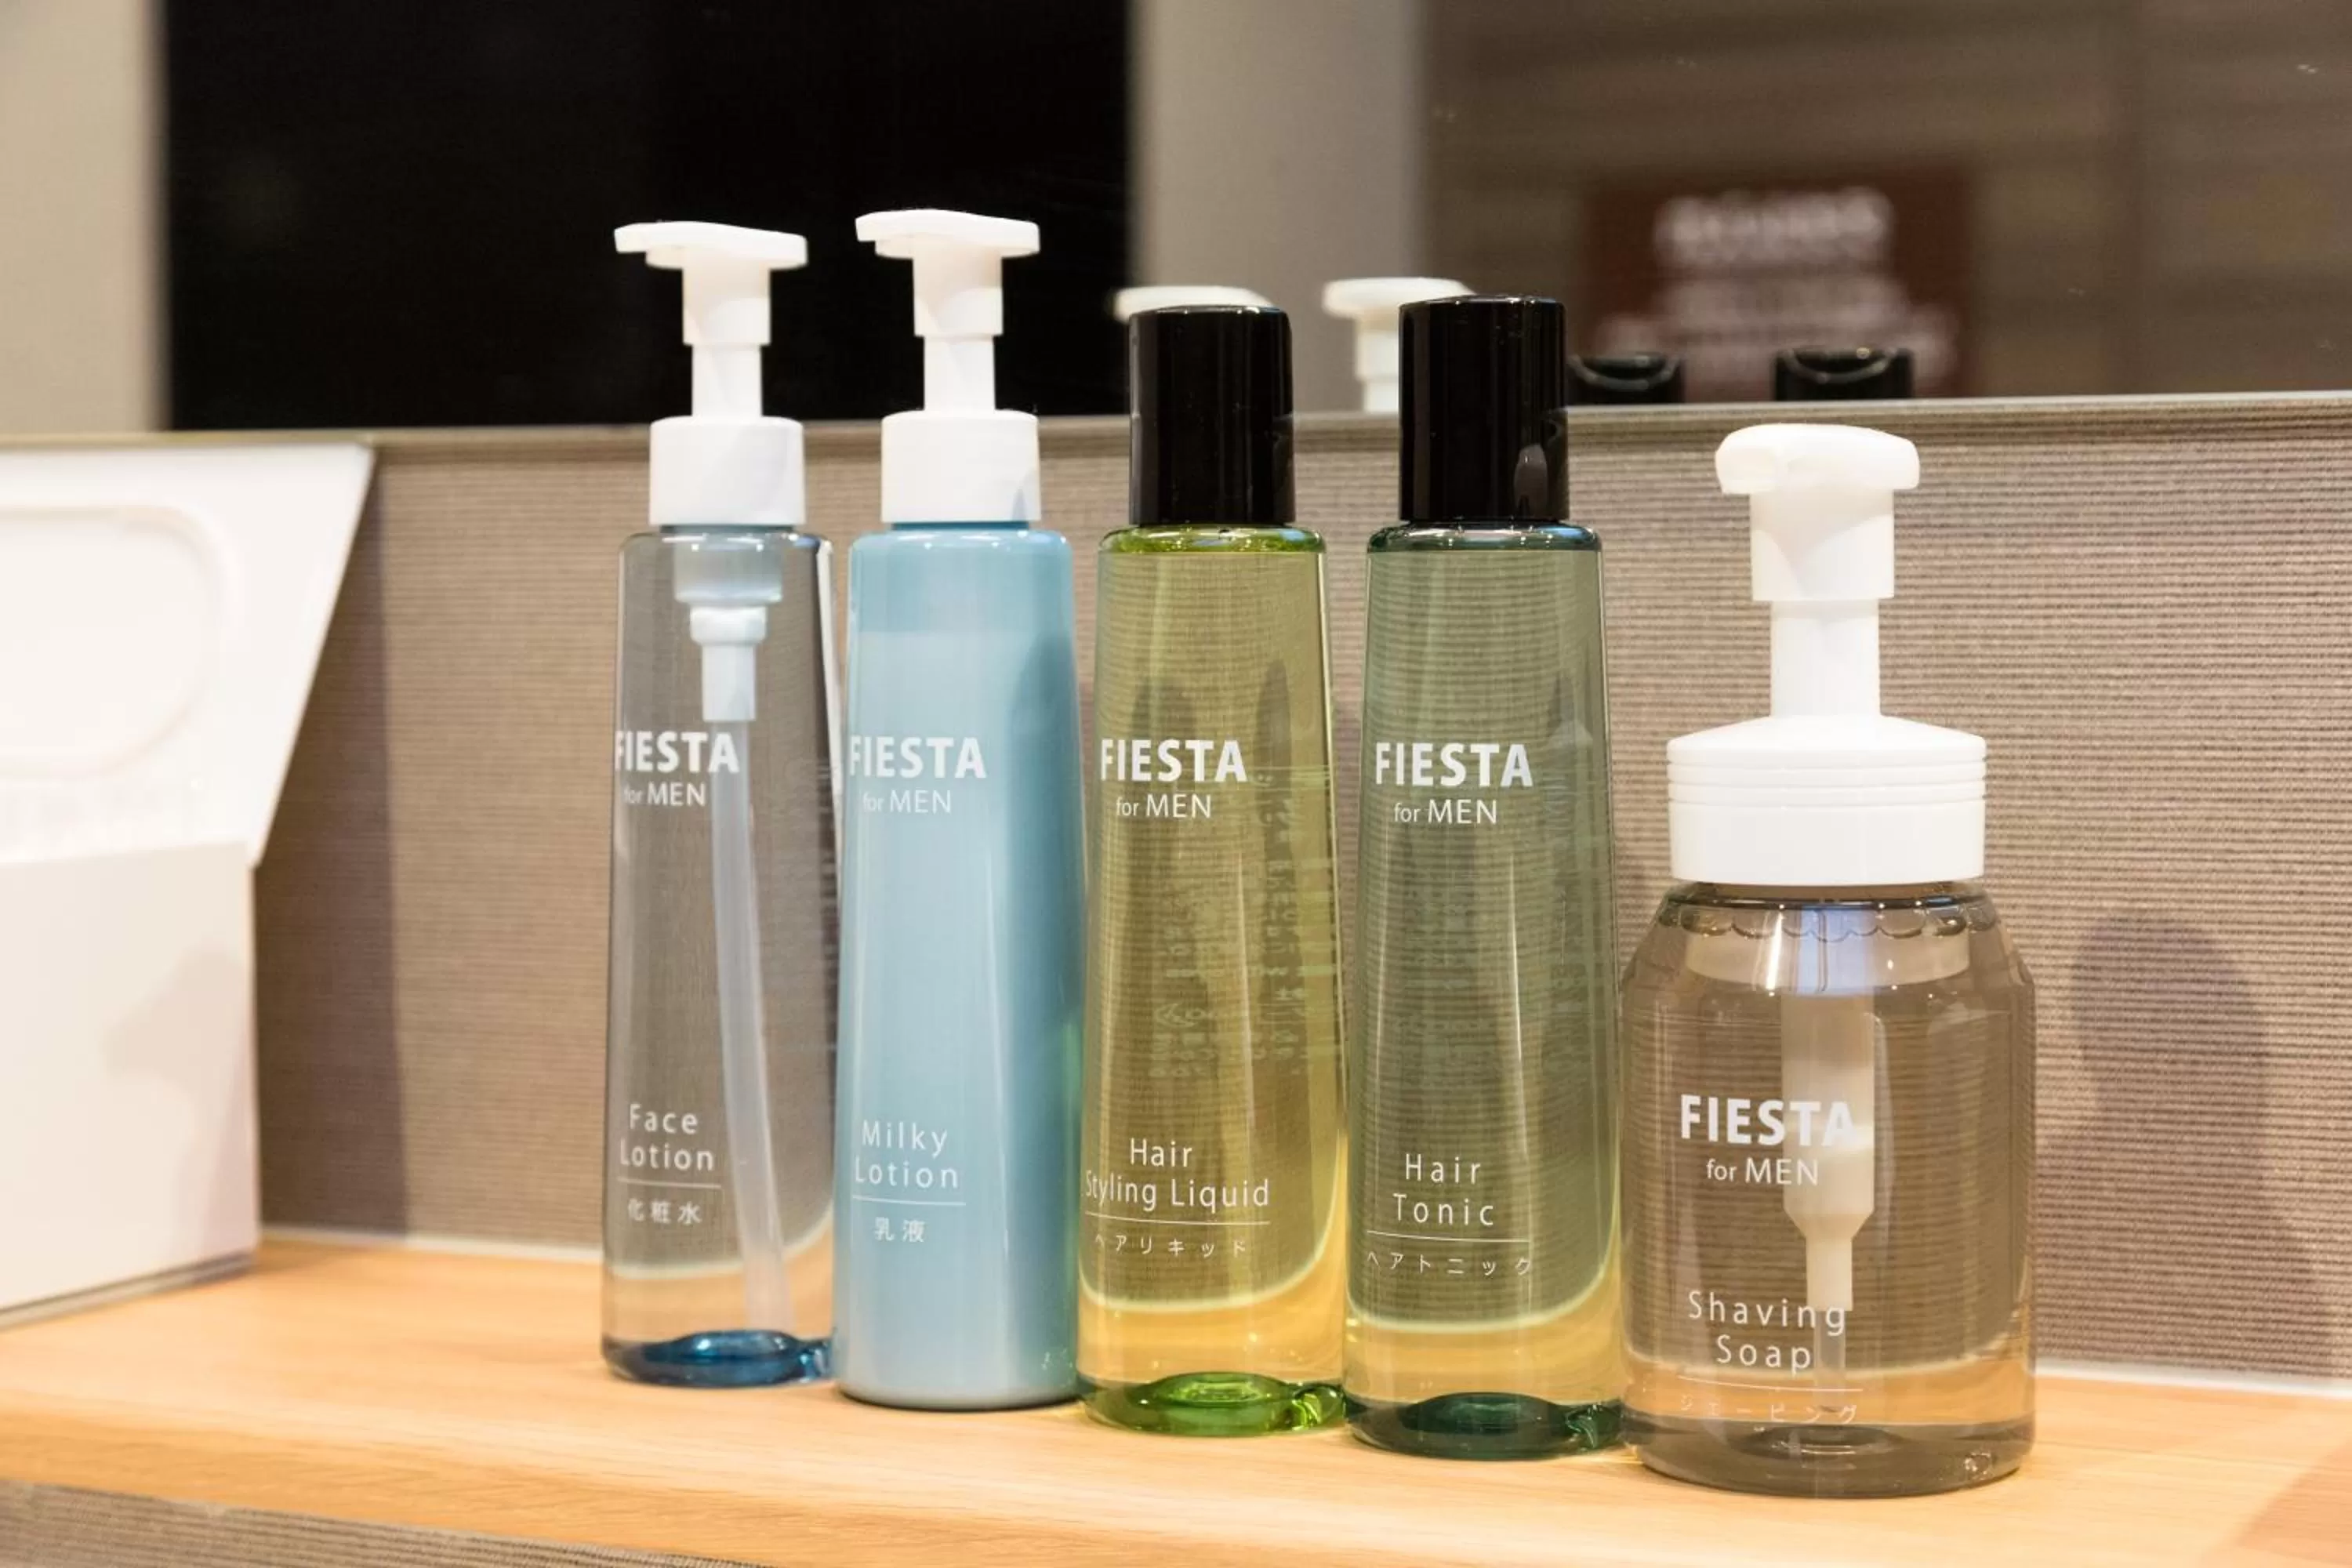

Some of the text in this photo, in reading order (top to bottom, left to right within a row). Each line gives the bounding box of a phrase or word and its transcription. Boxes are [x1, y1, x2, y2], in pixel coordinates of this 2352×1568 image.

[615, 730, 740, 774] FIESTA
[849, 735, 987, 779] FIESTA
[1100, 739, 1248, 783] FIESTA
[1375, 742, 1534, 788] FIESTA
[625, 781, 706, 808] for MEN
[862, 789, 952, 815] for MEN
[1116, 793, 1212, 819] for MEN
[1394, 799, 1498, 826] for MEN
[629, 1103, 699, 1135] Face
[1680, 1094, 1857, 1148] FIESTA
[619, 1138, 715, 1171] Lotion
[861, 1120, 949, 1158] Milky
[1130, 1137, 1193, 1168] Hair
[855, 1156, 960, 1189] Lotion
[1405, 1153, 1482, 1185] Hair
[1705, 1157, 1820, 1186] for MEN
[1085, 1170, 1271, 1214] Styling Liquid
[627, 1198, 702, 1225] 化粧水
[1392, 1192, 1495, 1227] Tonic
[873, 1215, 925, 1243] 乳液
[1094, 1234, 1247, 1258] ヘアリキッド
[1366, 1250, 1532, 1276] ヘアトニック
[1688, 1290, 1846, 1337] Shaving
[1716, 1334, 1811, 1377] Soap
